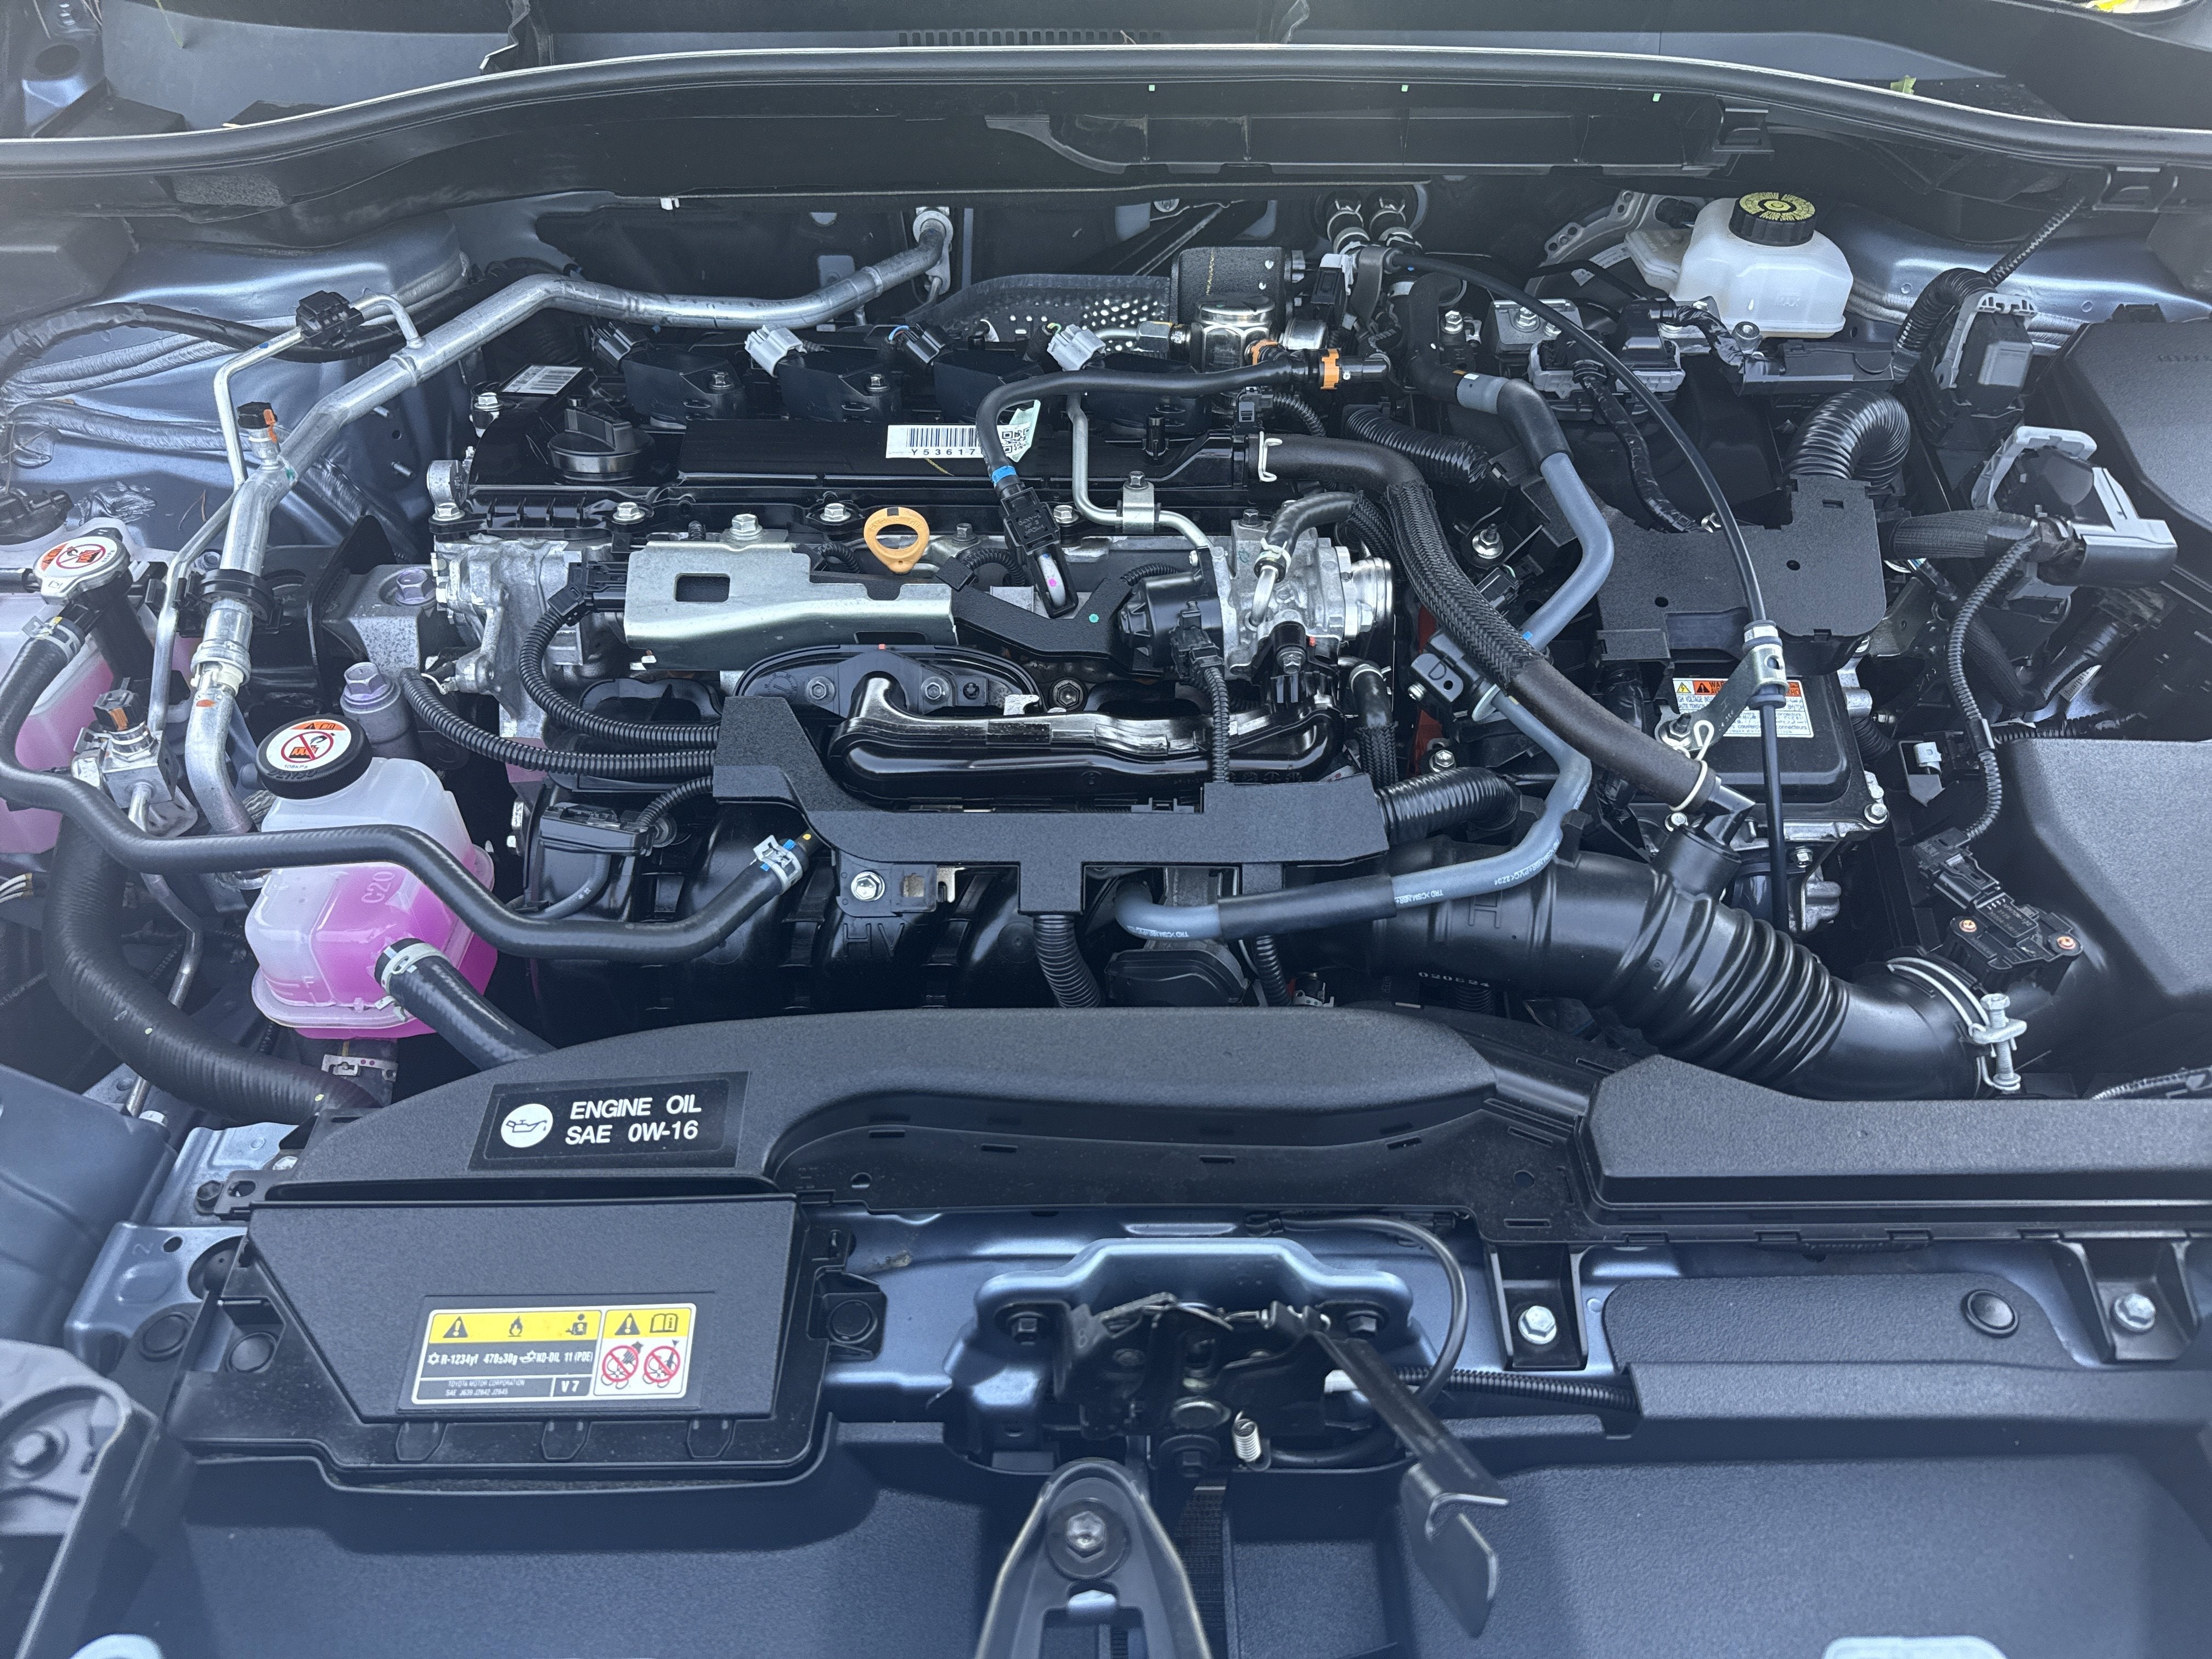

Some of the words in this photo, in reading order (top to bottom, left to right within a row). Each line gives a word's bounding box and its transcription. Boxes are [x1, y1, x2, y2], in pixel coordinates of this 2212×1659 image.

[361, 871, 395, 903] C20
[570, 1097, 653, 1120] ENGINE
[666, 1094, 702, 1114] OIL
[565, 1124, 613, 1145] SAE
[628, 1120, 698, 1142] 0W-16
